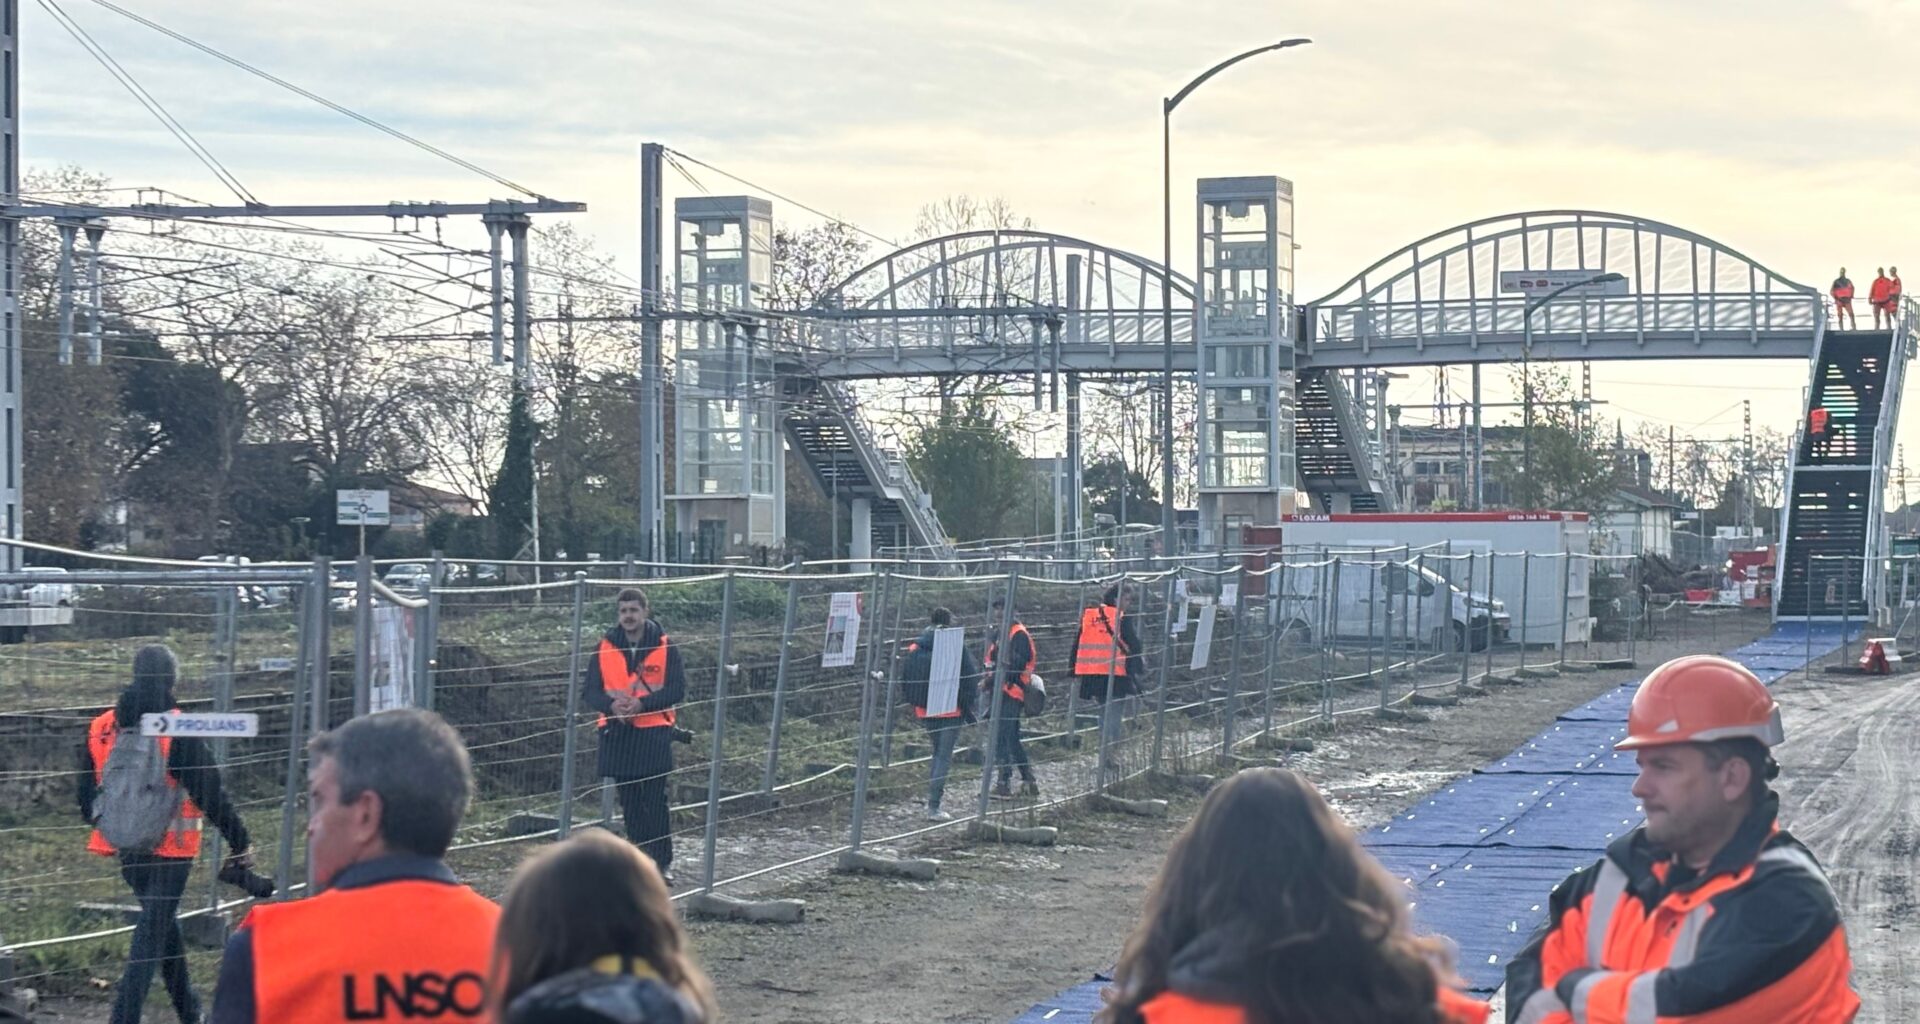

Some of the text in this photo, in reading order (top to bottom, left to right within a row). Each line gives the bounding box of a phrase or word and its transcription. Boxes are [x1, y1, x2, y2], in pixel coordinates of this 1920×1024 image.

[1299, 514, 1330, 522] LOXAM
[174, 719, 247, 731] PROLIANS
[343, 970, 486, 1020] LNSO
